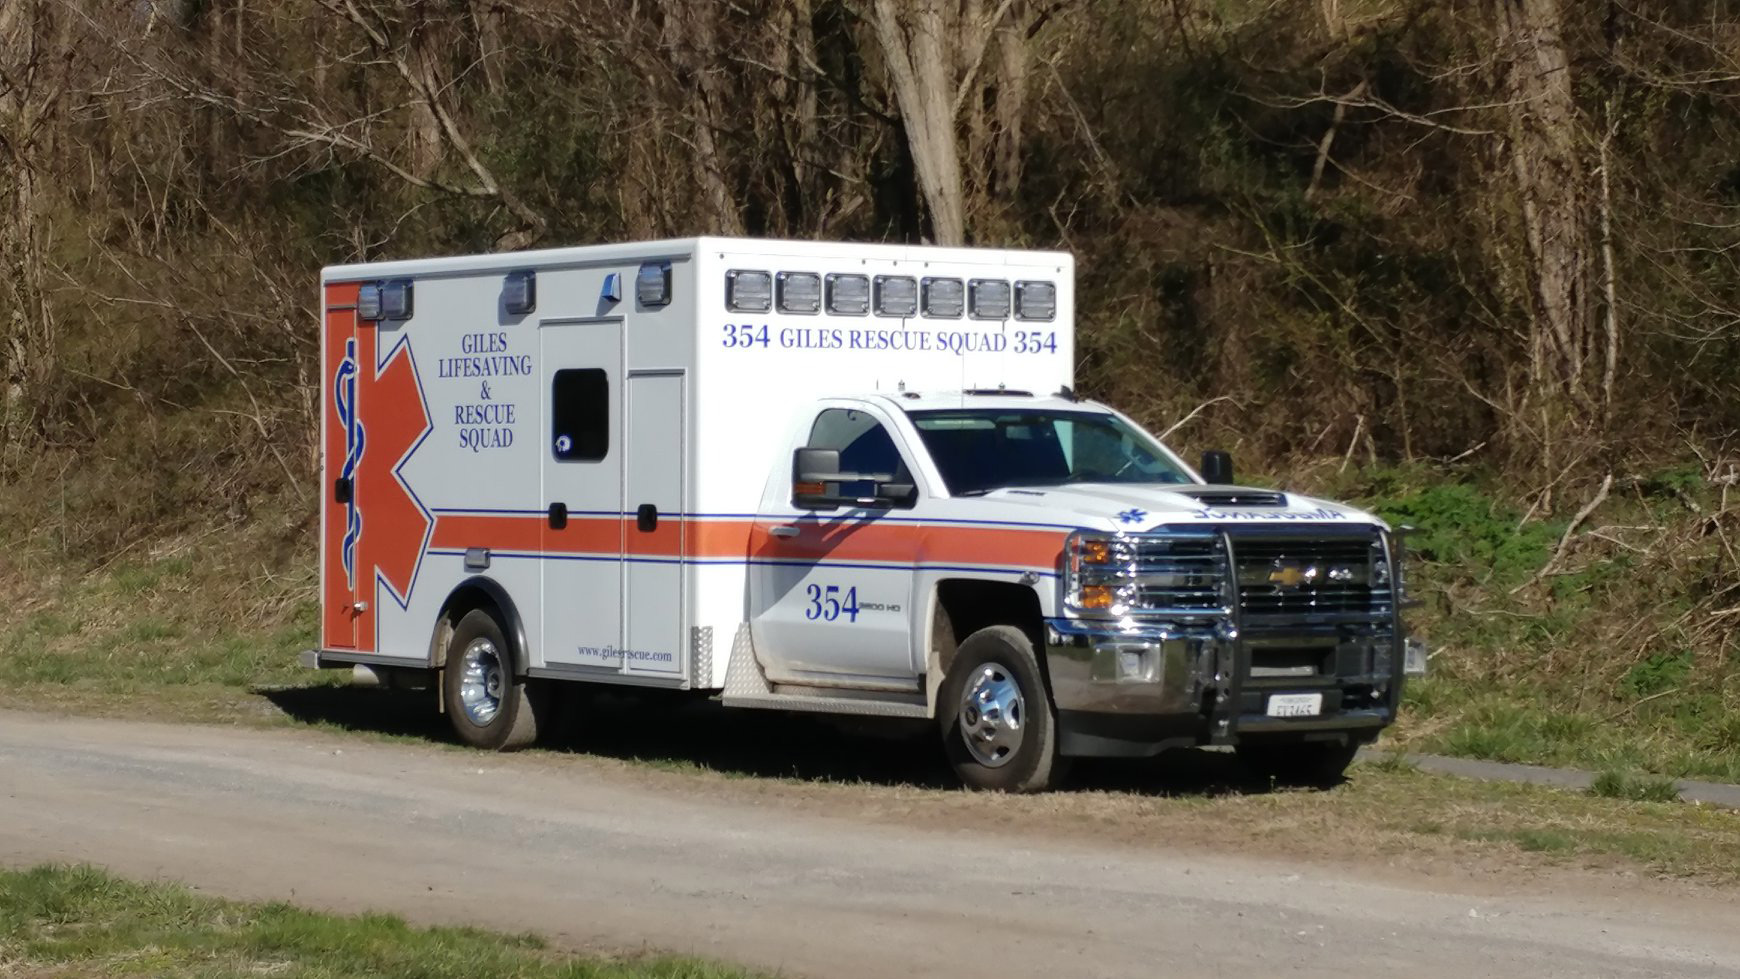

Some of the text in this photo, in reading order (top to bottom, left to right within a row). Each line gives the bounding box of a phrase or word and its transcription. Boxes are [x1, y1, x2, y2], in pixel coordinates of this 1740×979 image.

[461, 332, 507, 354] GILES
[722, 323, 1058, 356] 354 GILES RESCUE SQUAD 354
[438, 355, 532, 378] LIFESAVING
[480, 380, 491, 400] &
[454, 404, 516, 425] RESCUE
[459, 427, 513, 453] SQUAD
[806, 583, 860, 623] 354
